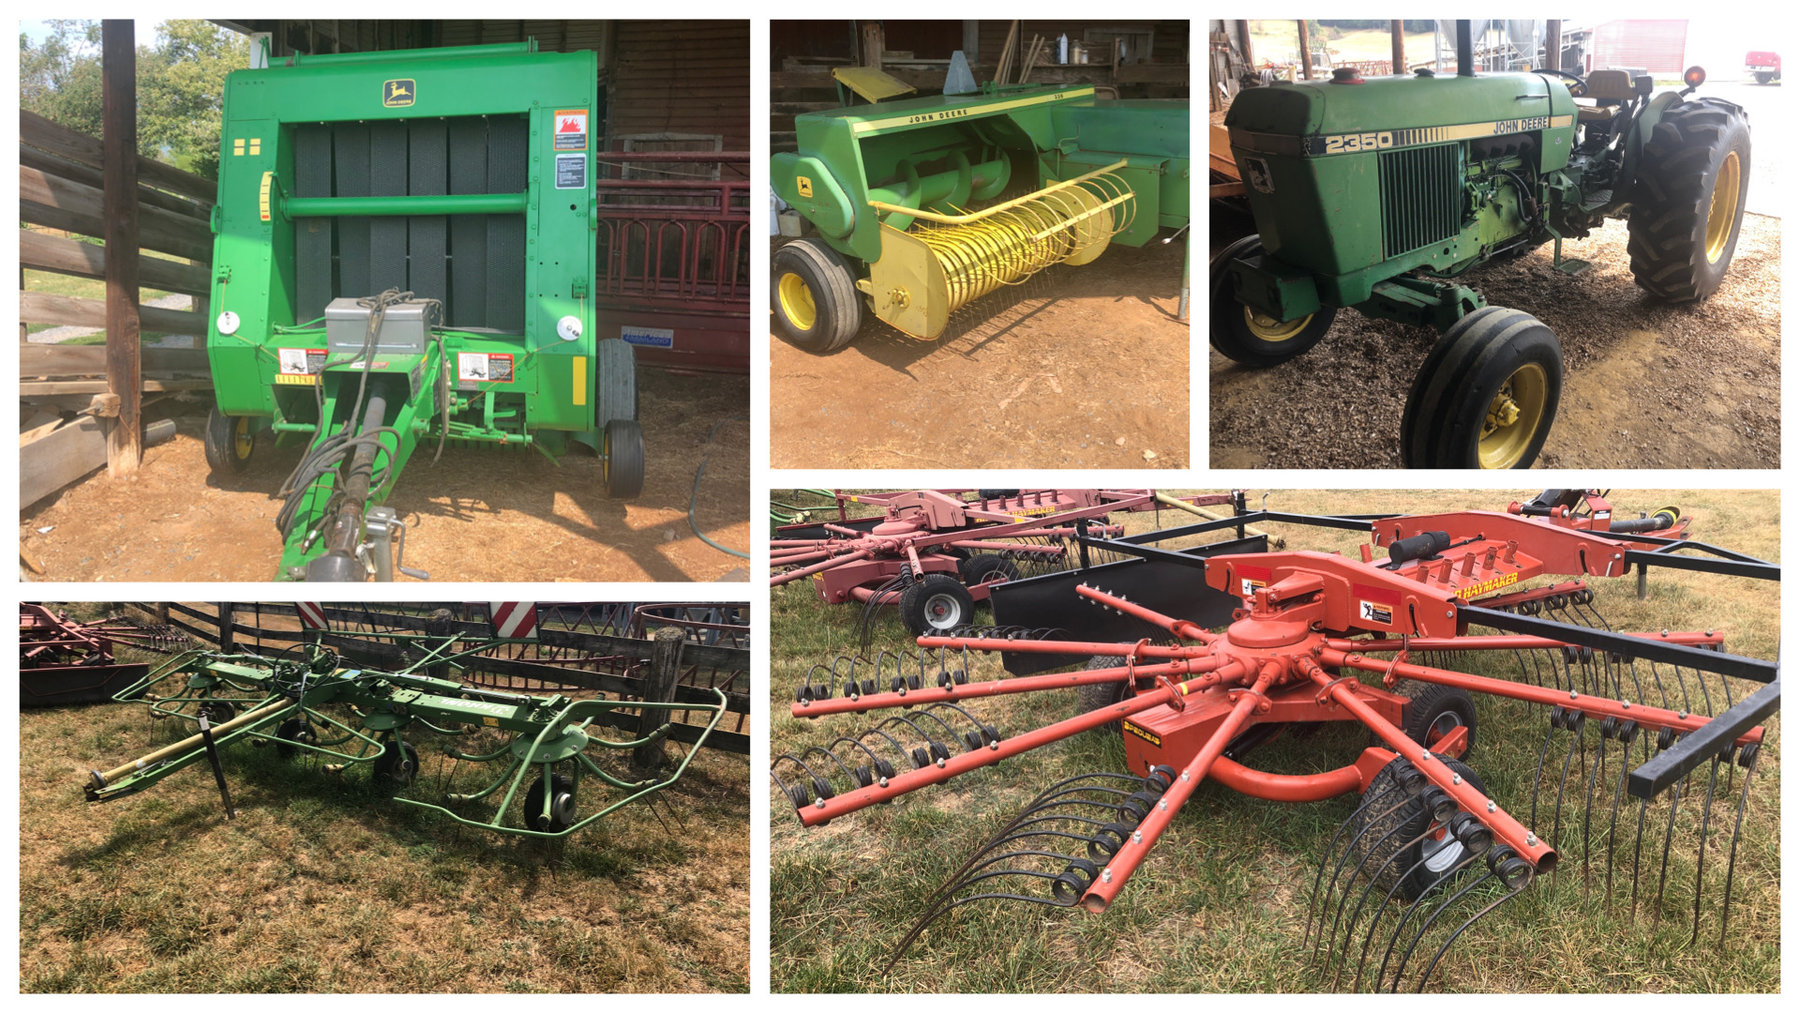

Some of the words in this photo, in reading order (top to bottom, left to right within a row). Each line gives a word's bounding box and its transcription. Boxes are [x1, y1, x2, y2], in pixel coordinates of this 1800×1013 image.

[909, 114, 934, 124] JOHN
[939, 109, 968, 120] DEERE
[1494, 120, 1518, 135] JOHN
[1521, 116, 1548, 131] DEERE
[1325, 131, 1393, 155] 2350
[1463, 572, 1518, 599] HAYMAKER
